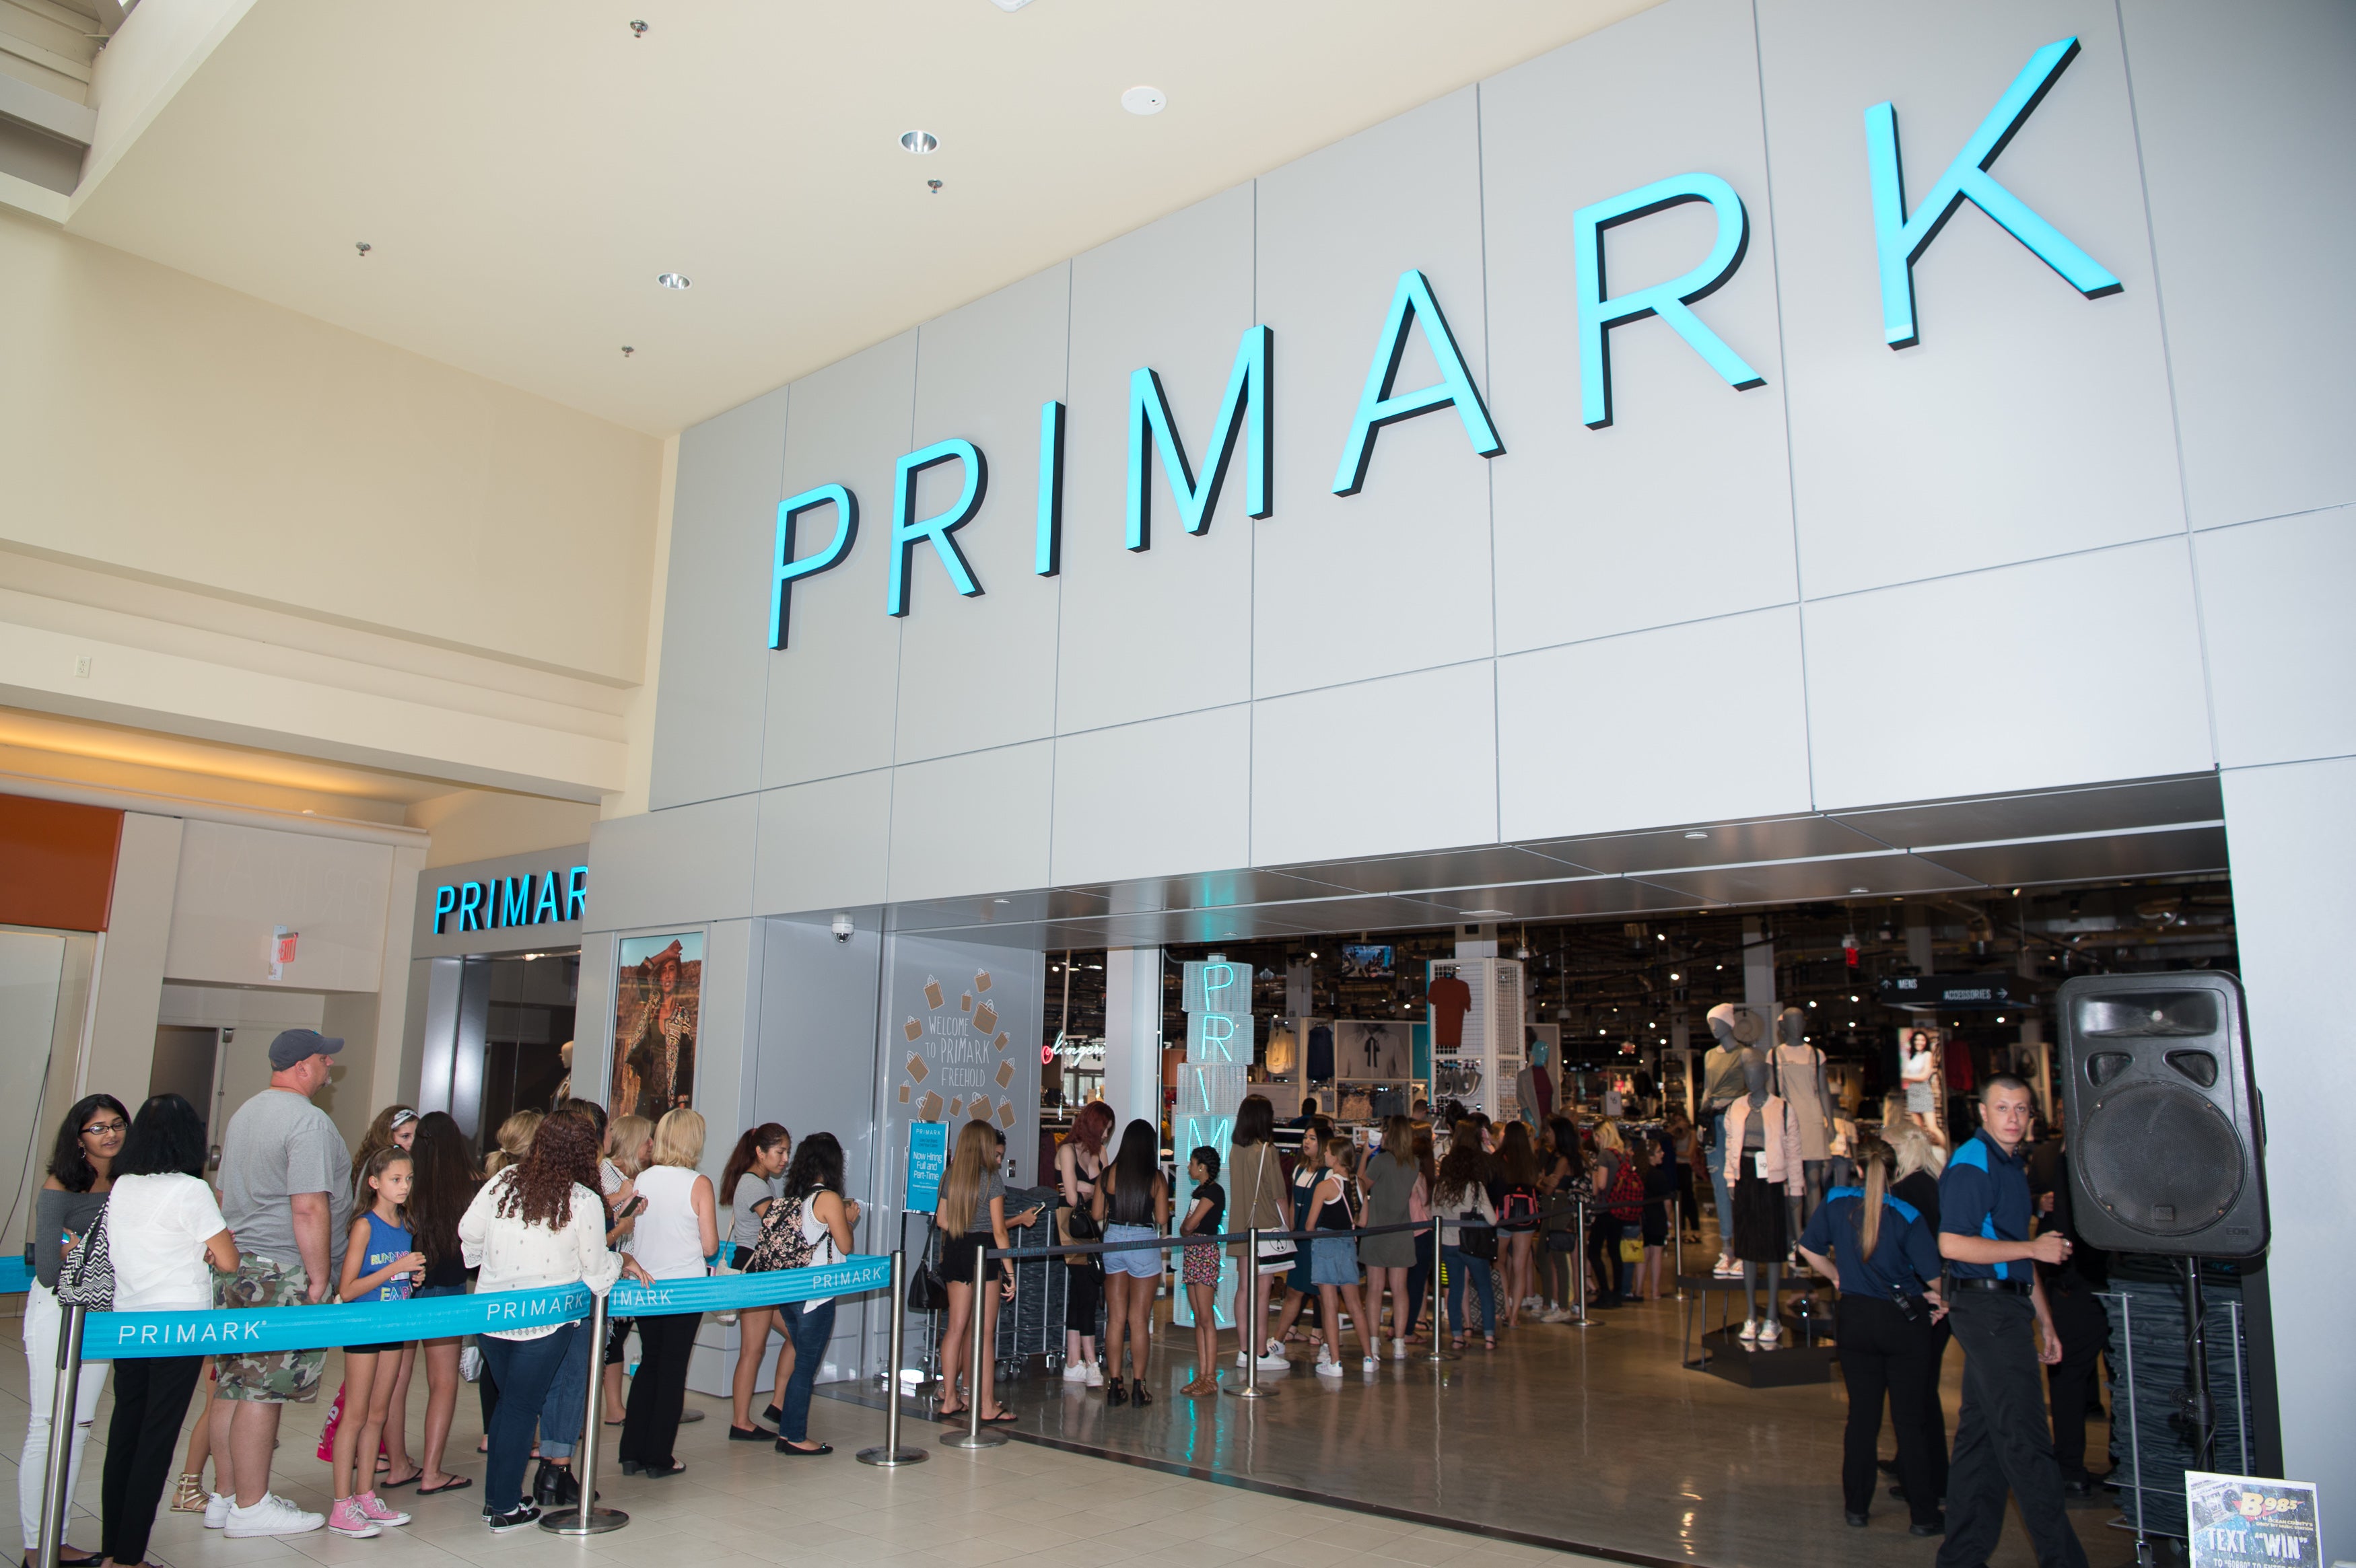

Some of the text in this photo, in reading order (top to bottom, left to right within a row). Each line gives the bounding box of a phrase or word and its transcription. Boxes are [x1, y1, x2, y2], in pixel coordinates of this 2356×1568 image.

[768, 36, 2122, 650] PRIMARK
[434, 865, 589, 935] PRIMAR
[280, 939, 293, 960] EXIT
[1897, 978, 1918, 989] MENS
[1944, 989, 1991, 1001] ACCESSORIES
[928, 1015, 969, 1036] WELCOME
[925, 1038, 990, 1064] TO PRIMARK
[1041, 1030, 1106, 1066] Lingeri
[942, 1067, 985, 1087] FREEHOLD
[913, 1151, 942, 1164] Now Hiring
[917, 1161, 937, 1170] Full and
[913, 1171, 939, 1181] Part-Time
[1006, 1248, 1047, 1257] PRIMARK
[1117, 1240, 1152, 1249] PRIMARK
[813, 1267, 882, 1289] PRIMARK
[380, 1286, 411, 1302] EMP
[613, 1290, 672, 1306] IMARK
[487, 1293, 584, 1320] PRIMARK
[118, 1320, 261, 1345] PRIMARK
[2207, 1528, 2308, 1559] TEXT "WIN"
[2213, 1558, 2223, 1567] TO
